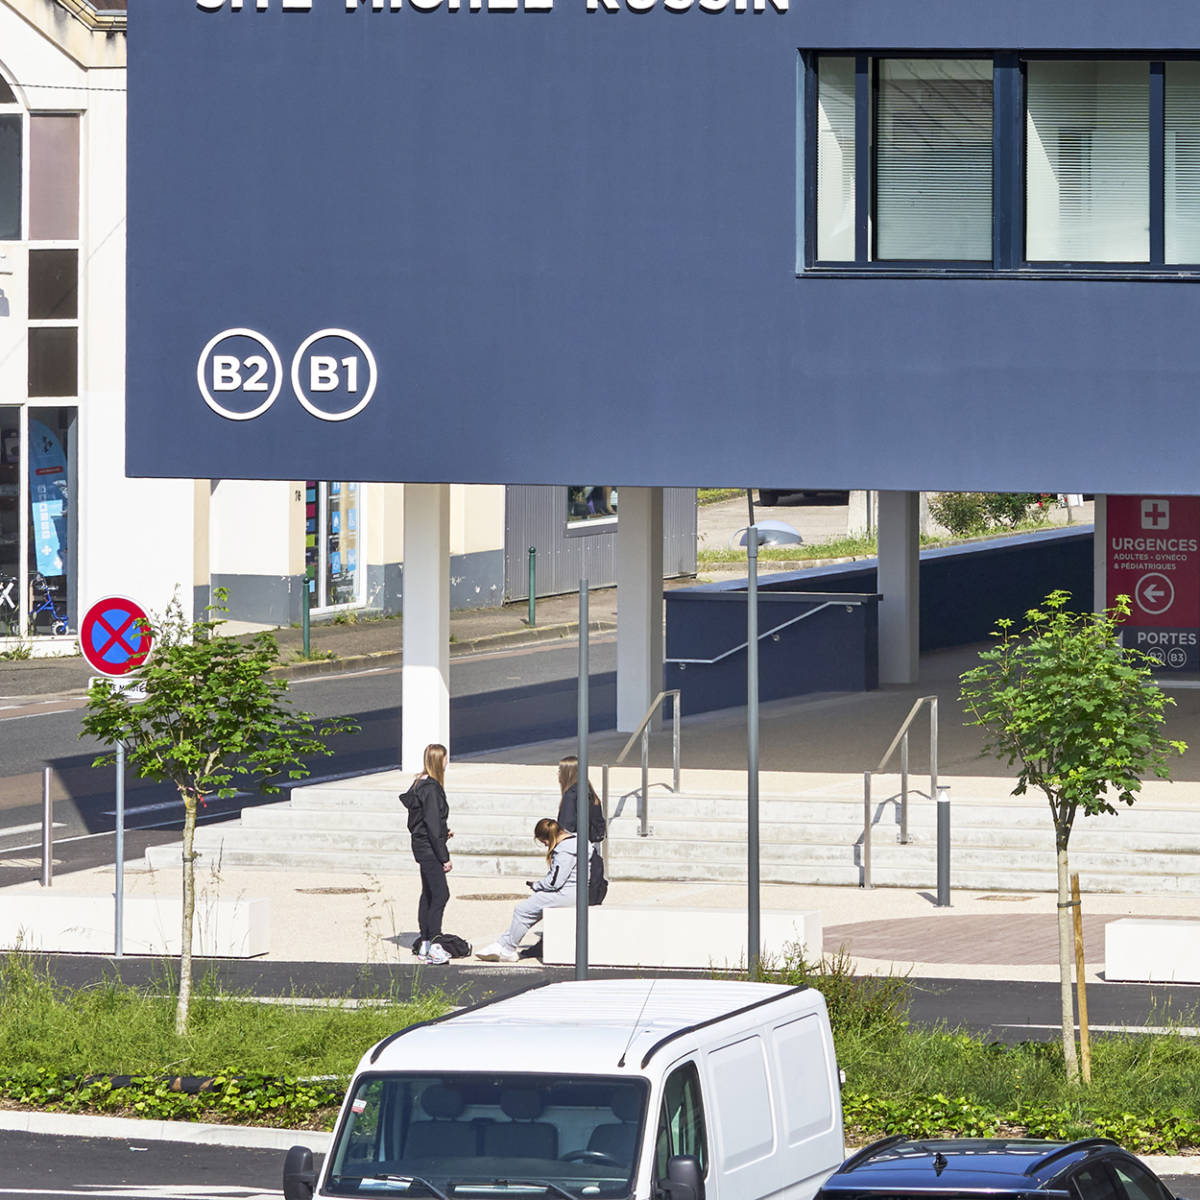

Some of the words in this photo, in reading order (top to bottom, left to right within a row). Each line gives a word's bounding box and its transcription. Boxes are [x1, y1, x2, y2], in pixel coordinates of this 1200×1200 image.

[213, 355, 269, 391] B2
[310, 355, 358, 392] B1
[1112, 537, 1198, 552] URGENCES
[1113, 553, 1149, 561] ADULTES
[1120, 562, 1177, 571] PÉDIATRIQUES
[1137, 631, 1197, 645] PORTES
[1170, 652, 1185, 662] B3
